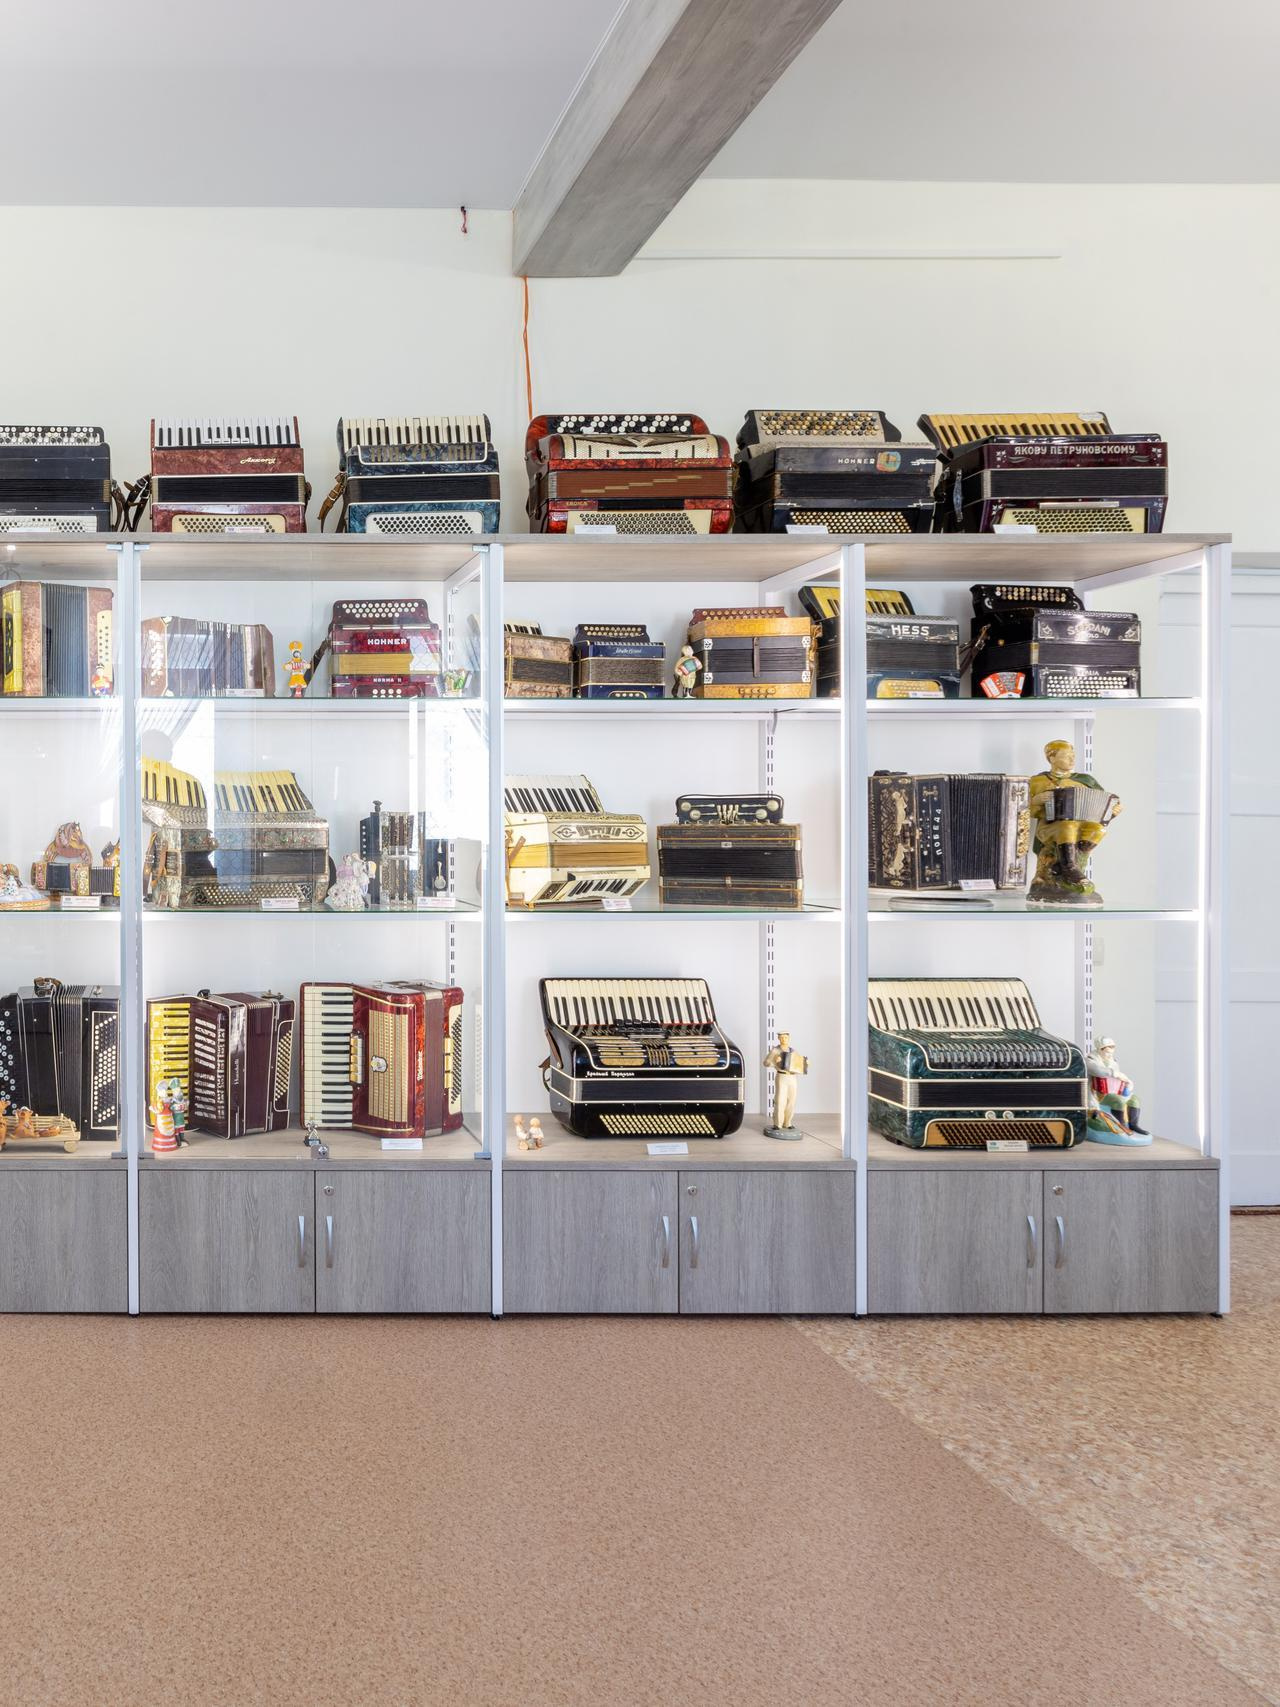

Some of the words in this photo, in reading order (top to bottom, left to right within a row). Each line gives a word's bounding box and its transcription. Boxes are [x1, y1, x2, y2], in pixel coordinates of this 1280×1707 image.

[1014, 446, 1047, 456] ЯКОВУ
[890, 624, 930, 636] HESS
[932, 807, 943, 856] ПОБЕДА
